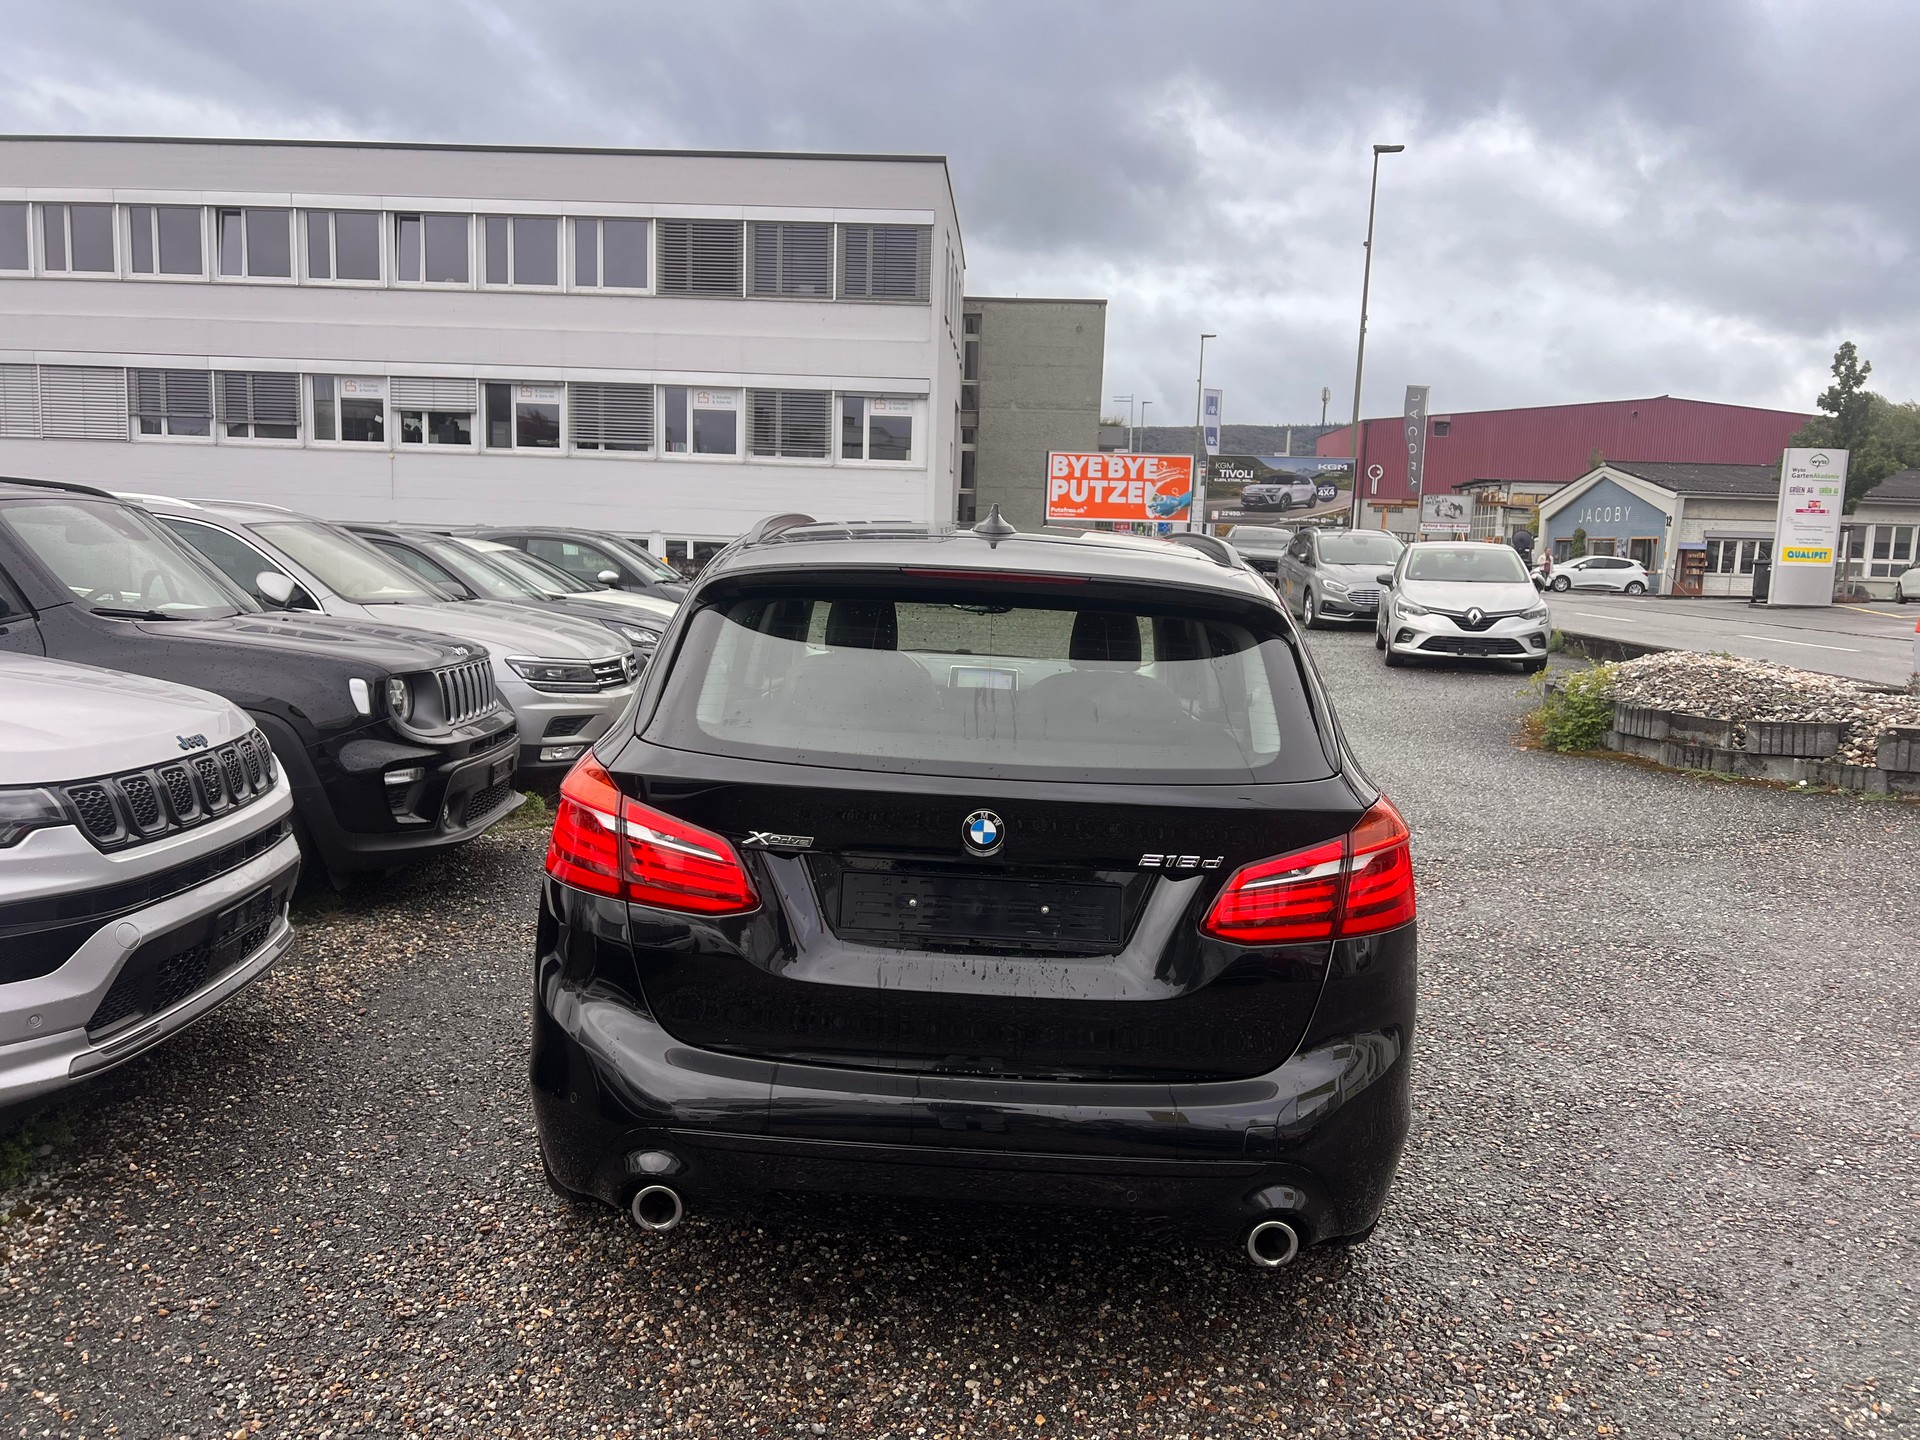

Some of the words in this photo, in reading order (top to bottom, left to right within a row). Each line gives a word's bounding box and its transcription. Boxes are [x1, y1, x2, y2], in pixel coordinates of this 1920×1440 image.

[1052, 455, 1103, 478] BYE
[1107, 457, 1159, 479] BYE
[1219, 469, 1254, 478] TIVOLI
[1318, 463, 1348, 471] KGM
[1579, 506, 1631, 523] JACOBY
[1787, 550, 1828, 560] QUALIPET
[176, 733, 208, 750] Jeep
[966, 811, 1002, 827] BMW
